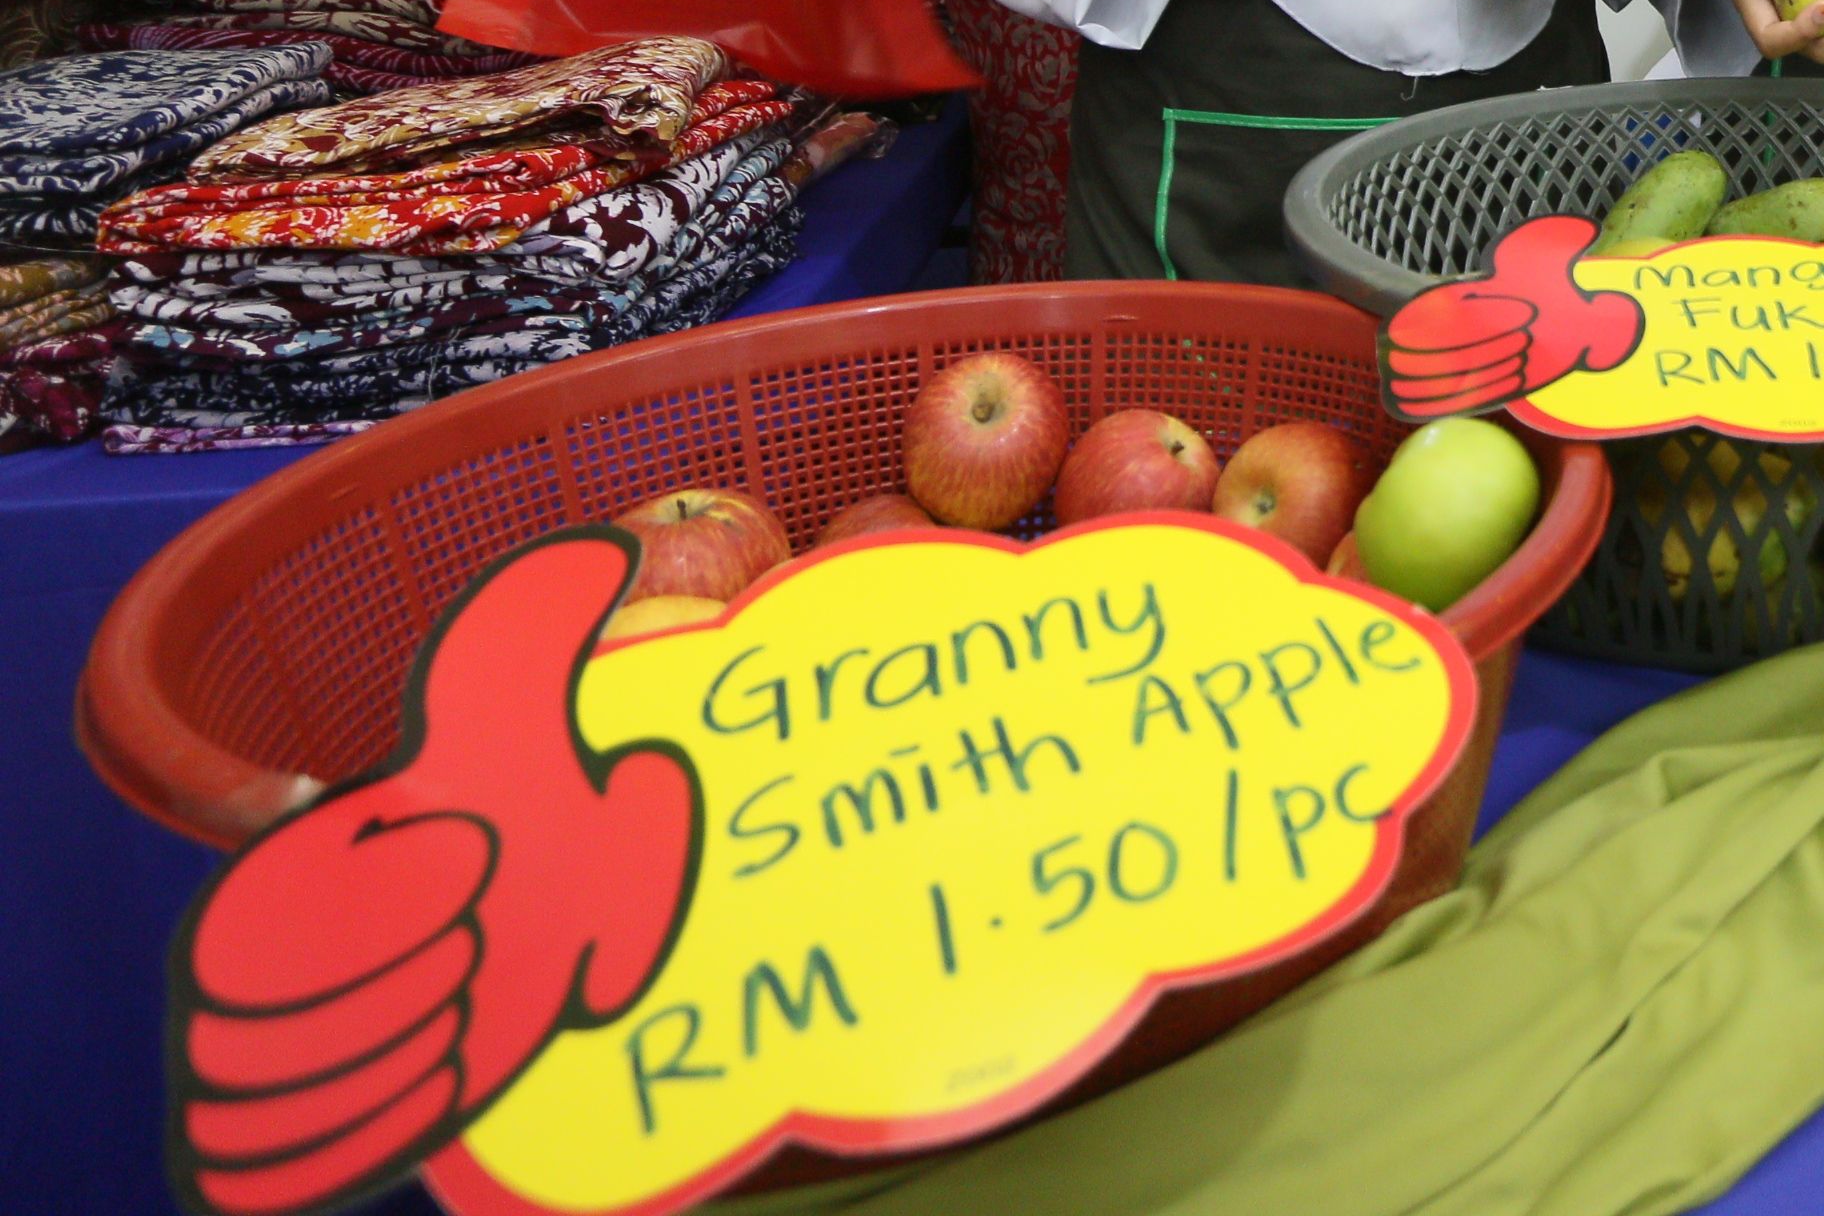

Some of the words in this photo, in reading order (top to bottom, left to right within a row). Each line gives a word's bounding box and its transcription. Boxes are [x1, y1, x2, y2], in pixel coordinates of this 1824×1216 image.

[1655, 345, 1778, 388] RM
[699, 582, 1167, 741] Granny
[726, 715, 1081, 879] Smith
[1131, 617, 1423, 751] Apple
[624, 943, 859, 1137] RM
